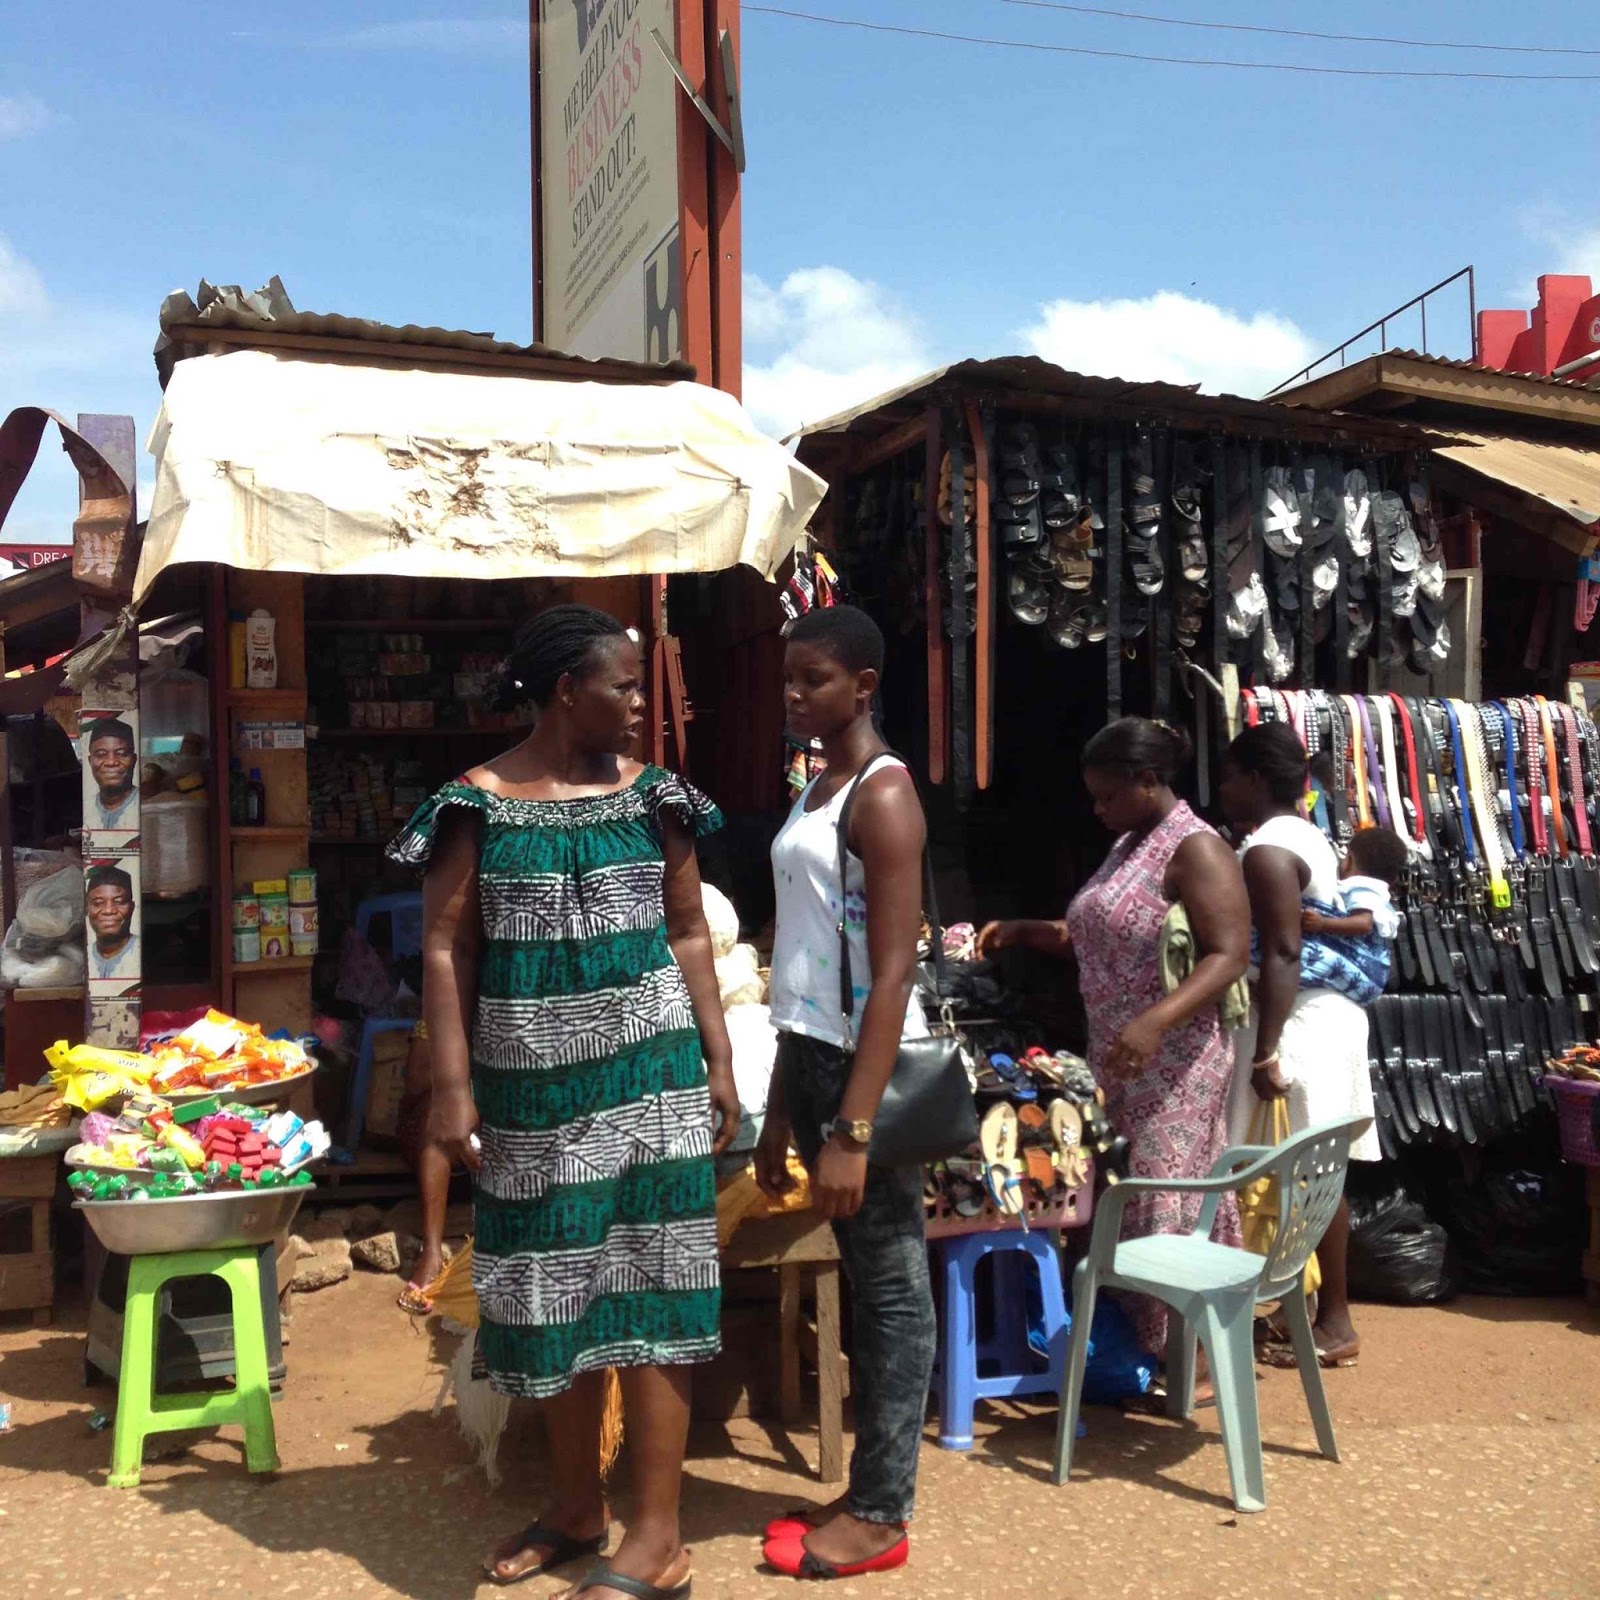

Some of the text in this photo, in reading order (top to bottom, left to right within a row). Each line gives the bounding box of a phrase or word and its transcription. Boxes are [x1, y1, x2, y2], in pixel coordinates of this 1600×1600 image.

[563, 0, 639, 139] WE HELP YO
[567, 20, 642, 205] BUSINESS
[572, 165, 606, 248] STAND
[607, 112, 636, 193] OUT!
